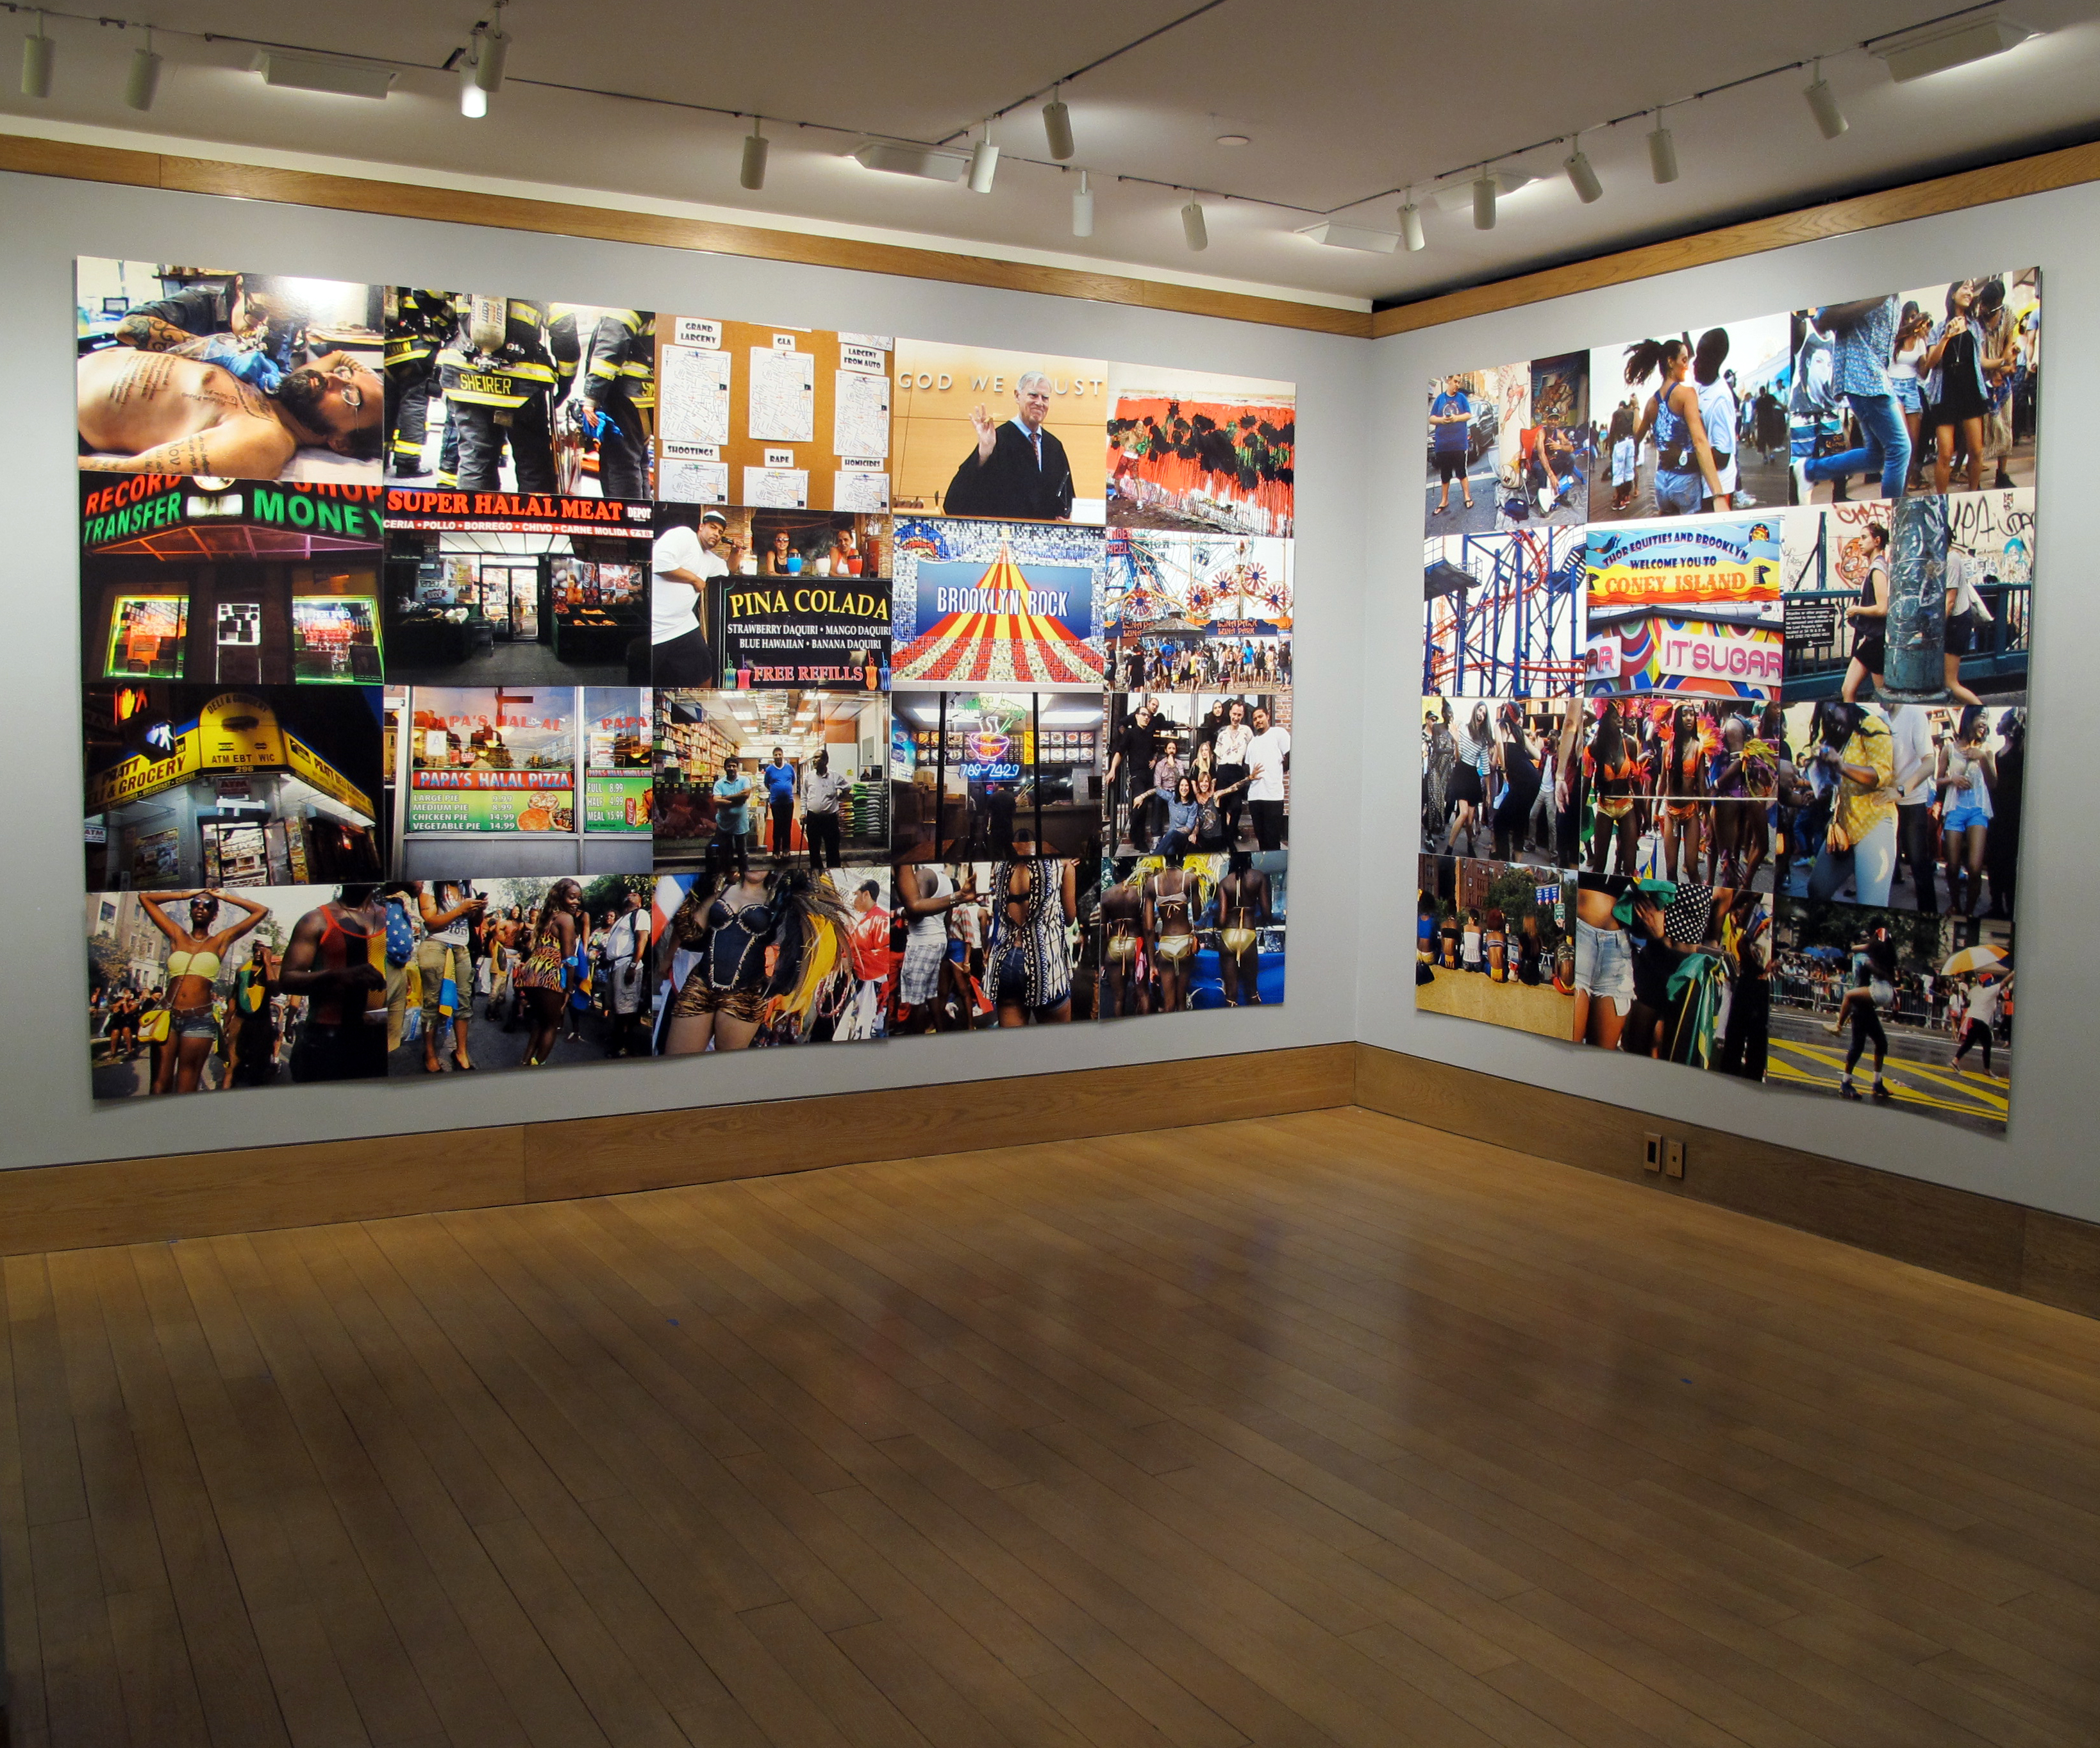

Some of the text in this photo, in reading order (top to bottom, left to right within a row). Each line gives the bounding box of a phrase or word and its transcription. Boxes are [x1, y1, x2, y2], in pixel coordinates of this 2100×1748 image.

[481, 301, 490, 323] SCOTT
[685, 322, 713, 333] GRAND
[680, 333, 717, 344] LARCENY
[778, 337, 791, 345] GLA
[848, 348, 877, 358] LARCENY
[844, 357, 881, 369] FROM AUTO
[460, 373, 512, 395] SHEIRER
[898, 372, 1103, 396] GOD WE UST
[668, 445, 713, 456] SHOOTINGS
[770, 455, 789, 463] RAPE
[845, 459, 881, 467] HOMICIDES
[85, 474, 183, 516] RECORD
[387, 490, 623, 521] SUPER HALAL MEAT
[83, 488, 383, 544] TRANSFER MONEY
[627, 506, 652, 520] DEPOT
[383, 520, 415, 529] CERIA
[422, 521, 456, 530] POLLO
[463, 522, 513, 531] BORREGO
[522, 524, 553, 533] CHIVO
[560, 525, 593, 535] CARNE
[595, 528, 629, 537] MOLIDA
[1603, 531, 1749, 567] THOR EQUITIES AND BROOKLYN
[1629, 555, 1717, 570] WELCOME YOU TO
[1604, 572, 1747, 594] CONEY ISLAND
[729, 588, 890, 620] PINA COLADA
[937, 587, 1069, 617] BROOKLYN ROCK
[728, 624, 892, 637] STRAWBERRY DAQUIRI MANGO DAQUIRI
[739, 638, 881, 651] BLUE HAWAIIAN BANANA DAQUIRI
[753, 665, 865, 682] FREE REFILLS
[206, 697, 224, 714] DELI
[226, 694, 231, 704] &
[424, 714, 488, 729] PAPA'S
[212, 754, 276, 763] ATM EBT WIC
[119, 754, 187, 795] GROCERY
[421, 772, 569, 788] PAPA'S HALAL PIZZA
[220, 780, 247, 788] ATM
[587, 783, 624, 794] FULL 8.99
[587, 796, 624, 808] HALF 4.99
[587, 810, 624, 821] MEAL 15.99
[490, 822, 515, 830] 14.99
